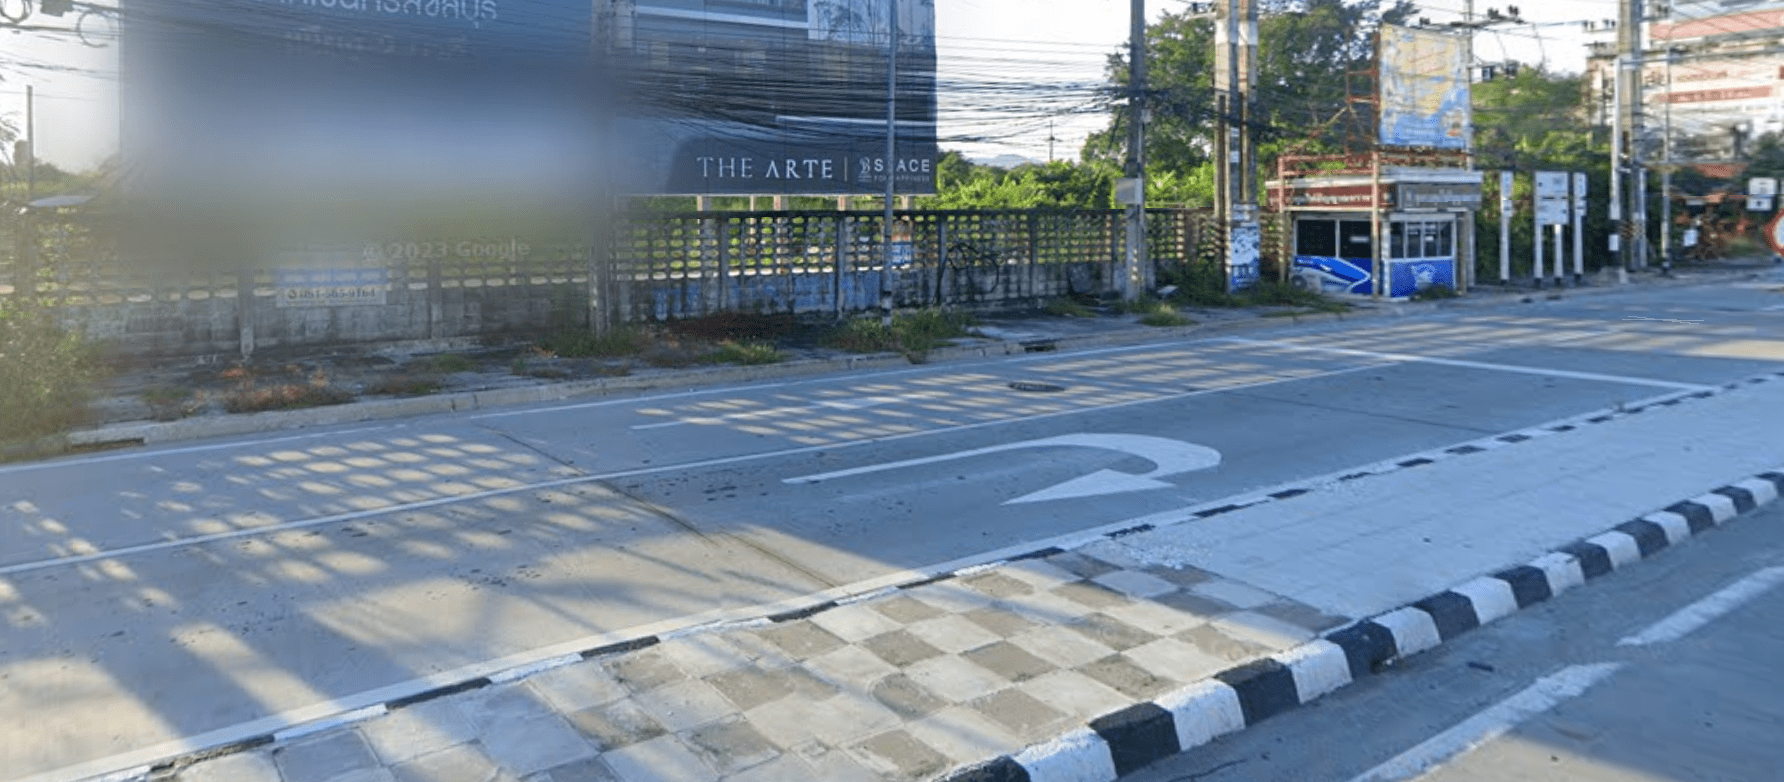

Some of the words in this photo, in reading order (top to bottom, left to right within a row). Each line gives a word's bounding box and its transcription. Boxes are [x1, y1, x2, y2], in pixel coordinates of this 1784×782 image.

[696, 157, 753, 178] THE
[765, 159, 833, 179] ARTE
[873, 158, 930, 173] SACE
